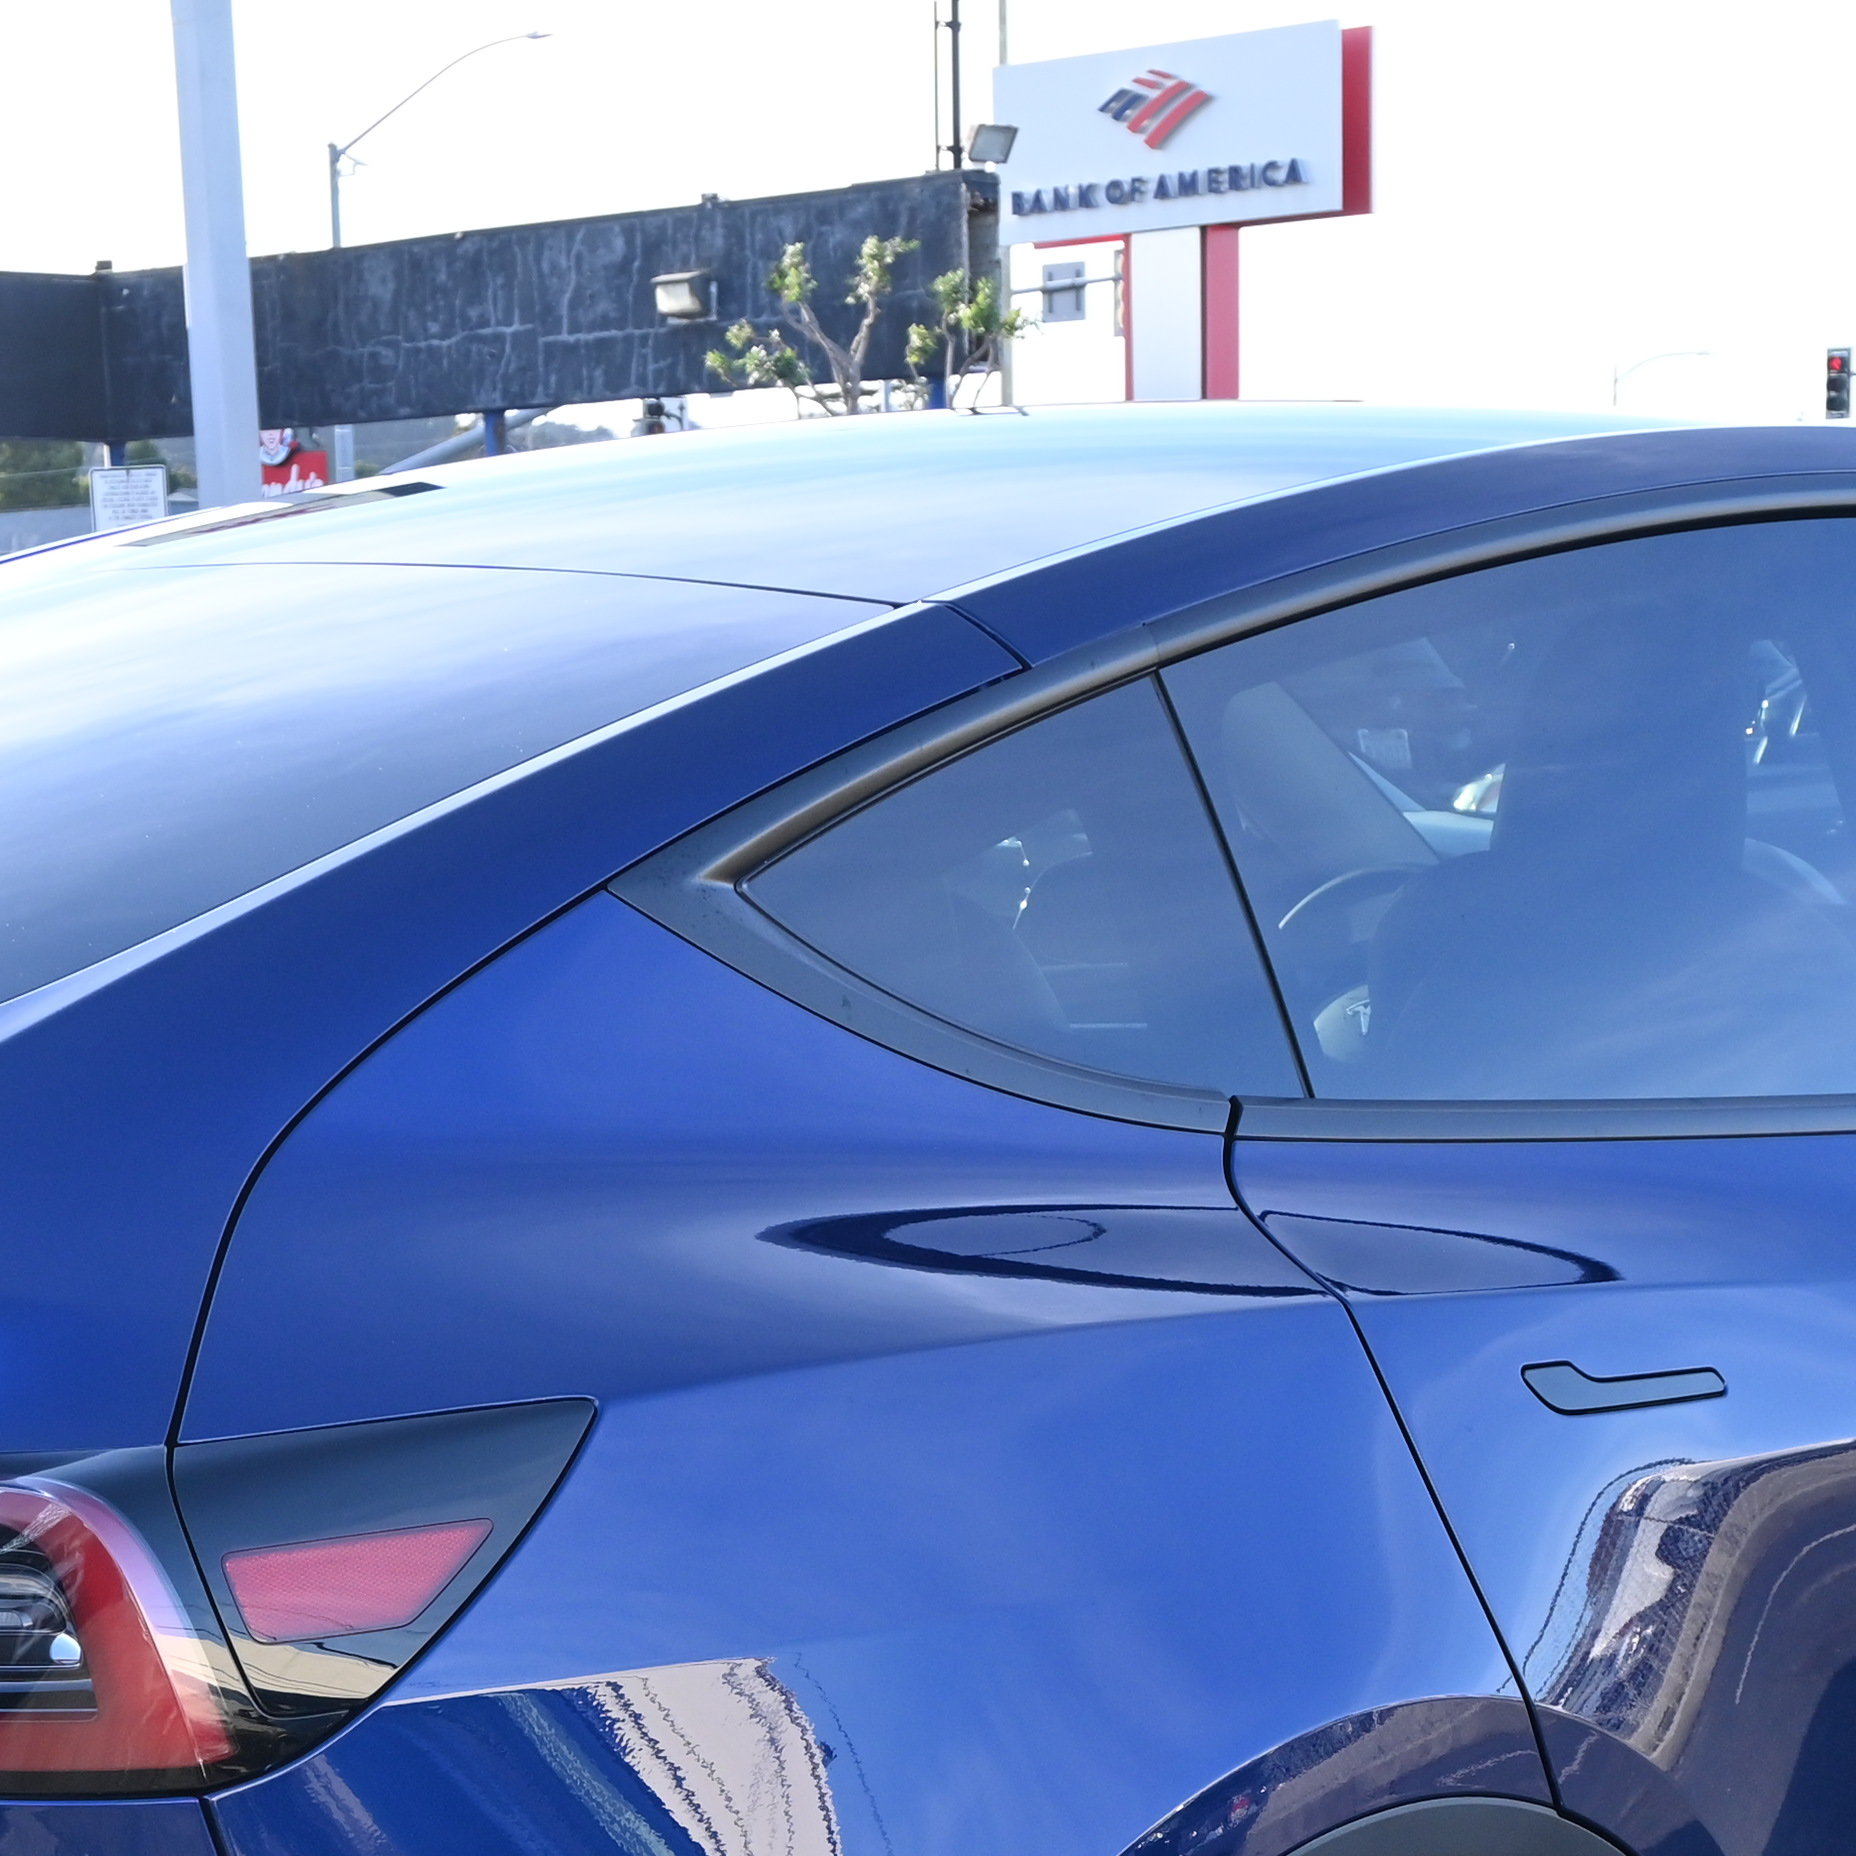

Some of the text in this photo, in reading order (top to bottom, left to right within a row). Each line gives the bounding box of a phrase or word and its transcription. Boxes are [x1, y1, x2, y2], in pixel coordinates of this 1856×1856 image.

[1012, 157, 1305, 216] BANK OF AMERICA
